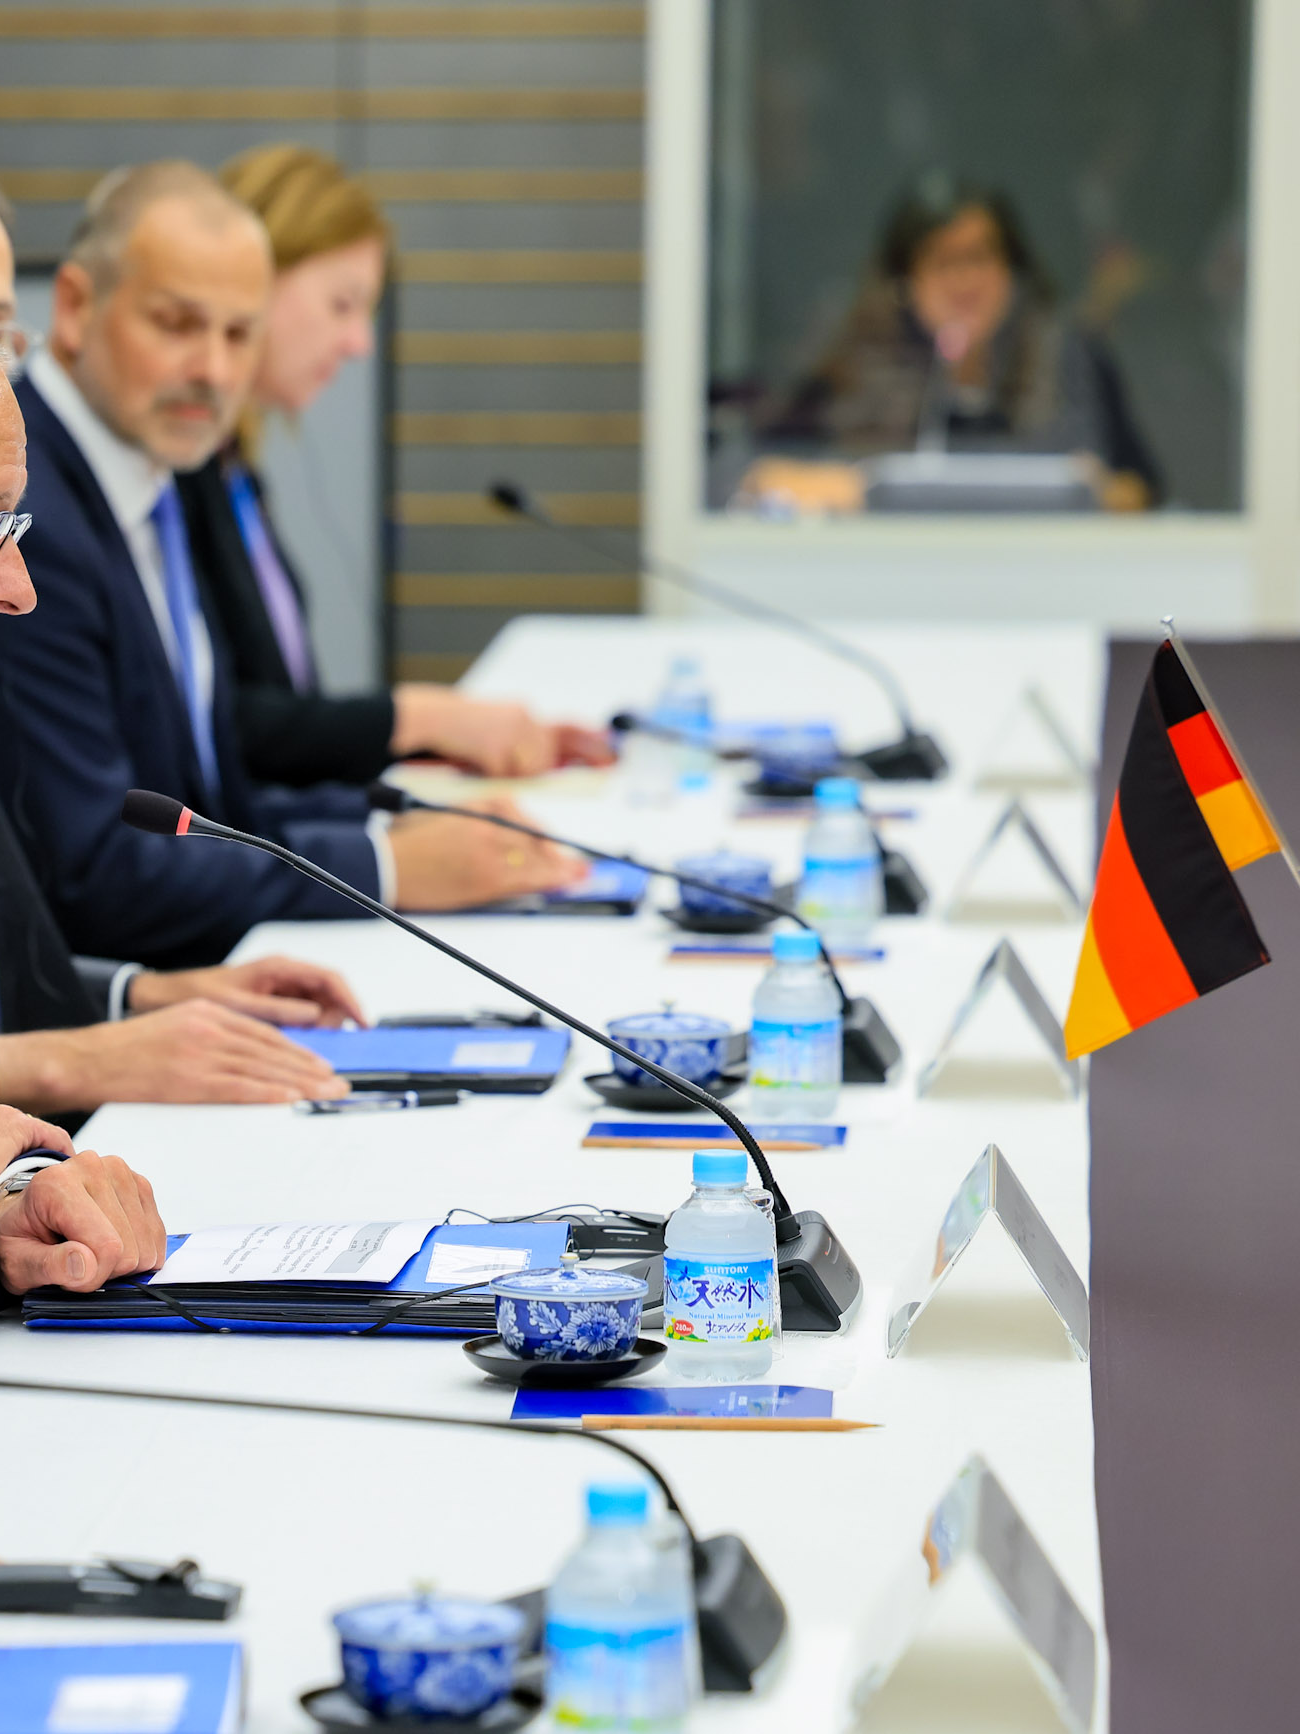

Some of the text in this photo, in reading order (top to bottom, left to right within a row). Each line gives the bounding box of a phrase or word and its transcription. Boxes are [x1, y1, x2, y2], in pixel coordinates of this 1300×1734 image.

[704, 1266, 748, 1274] SUNTORY
[685, 1277, 764, 1309] 天然水
